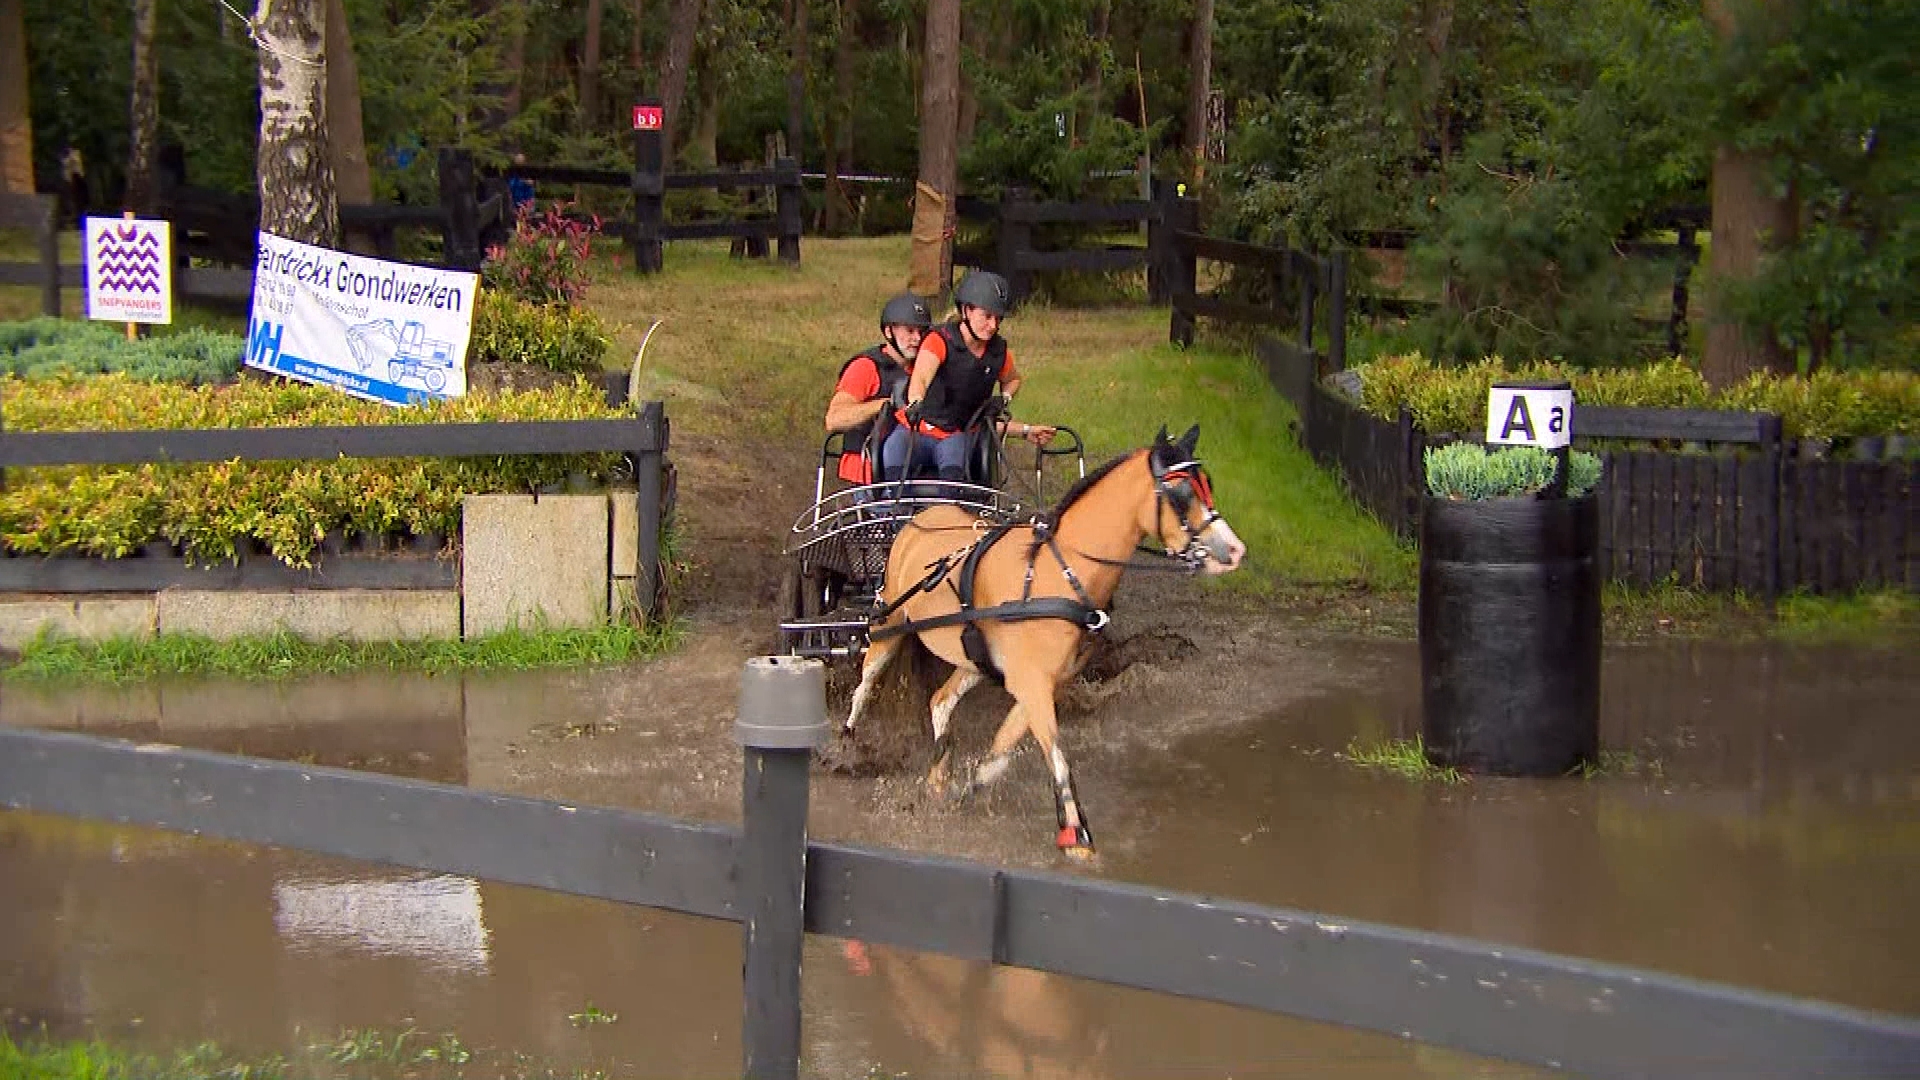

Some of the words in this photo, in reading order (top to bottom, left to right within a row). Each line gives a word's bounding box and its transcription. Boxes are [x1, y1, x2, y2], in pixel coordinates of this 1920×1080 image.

[98, 297, 162, 310] SNEPVANGERS
[337, 261, 462, 312] Grondwerken
[1500, 394, 1536, 441] A
[1549, 405, 1564, 434] a
